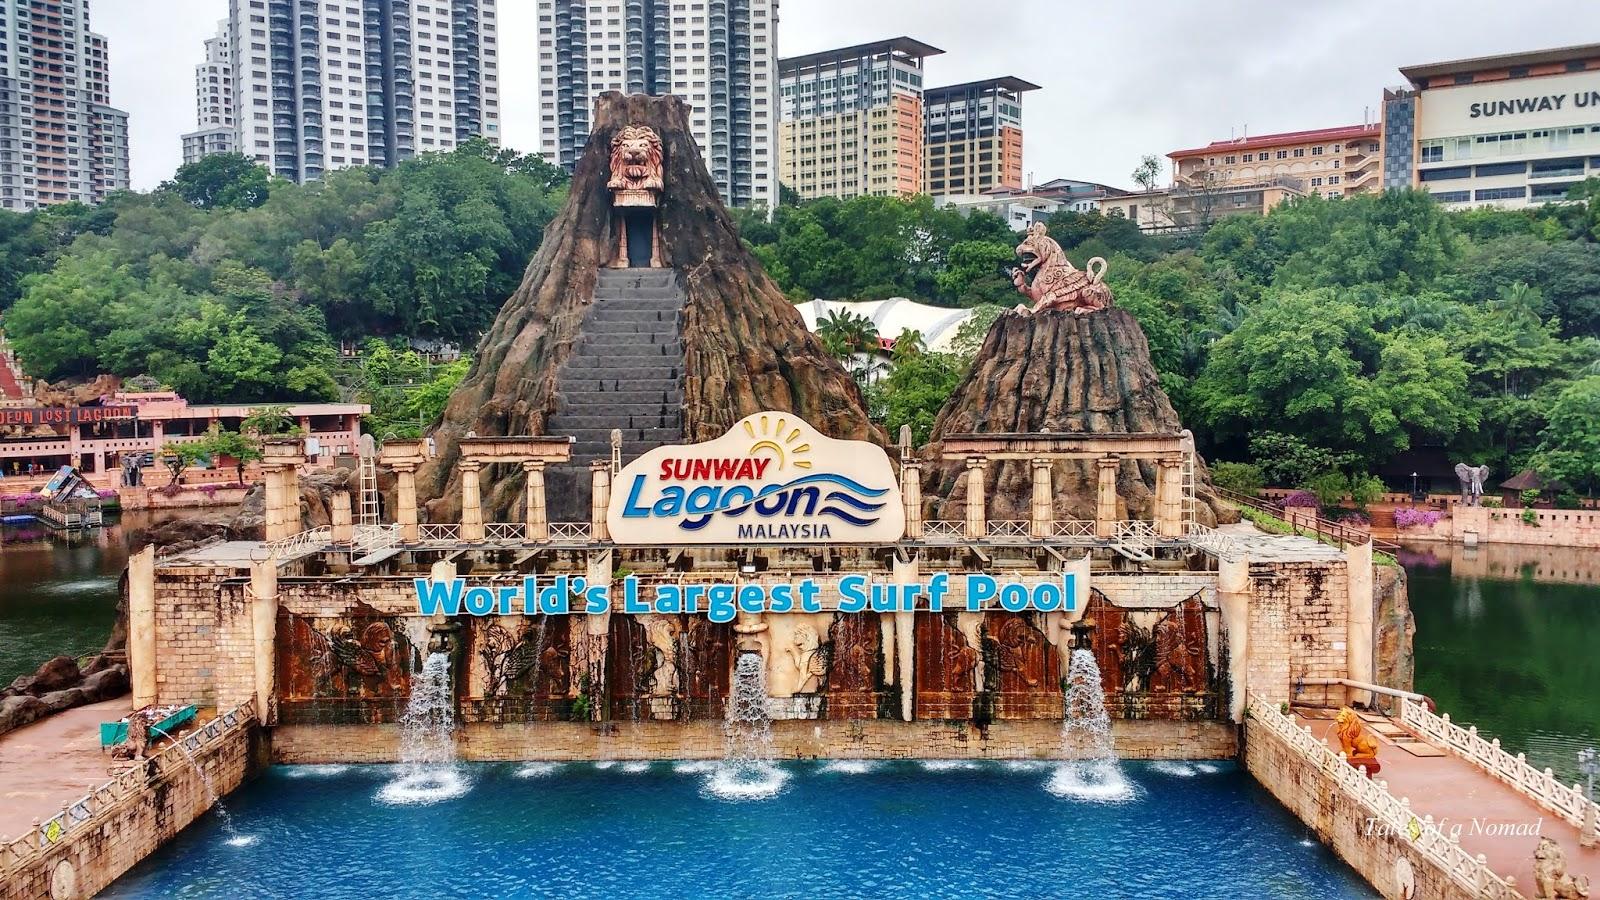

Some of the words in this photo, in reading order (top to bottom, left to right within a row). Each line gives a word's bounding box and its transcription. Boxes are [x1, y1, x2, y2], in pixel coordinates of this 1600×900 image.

[1470, 94, 1566, 118] SUNWAY
[40, 409, 71, 423] LOST
[78, 407, 131, 421] LAGOON
[660, 458, 771, 480] SUNWAY
[622, 474, 820, 531] Lagoon
[738, 524, 831, 538] MALAYSIA
[414, 575, 609, 616] World's
[624, 575, 822, 622] Largest
[838, 572, 950, 613] Surf
[966, 572, 1077, 612] Pool
